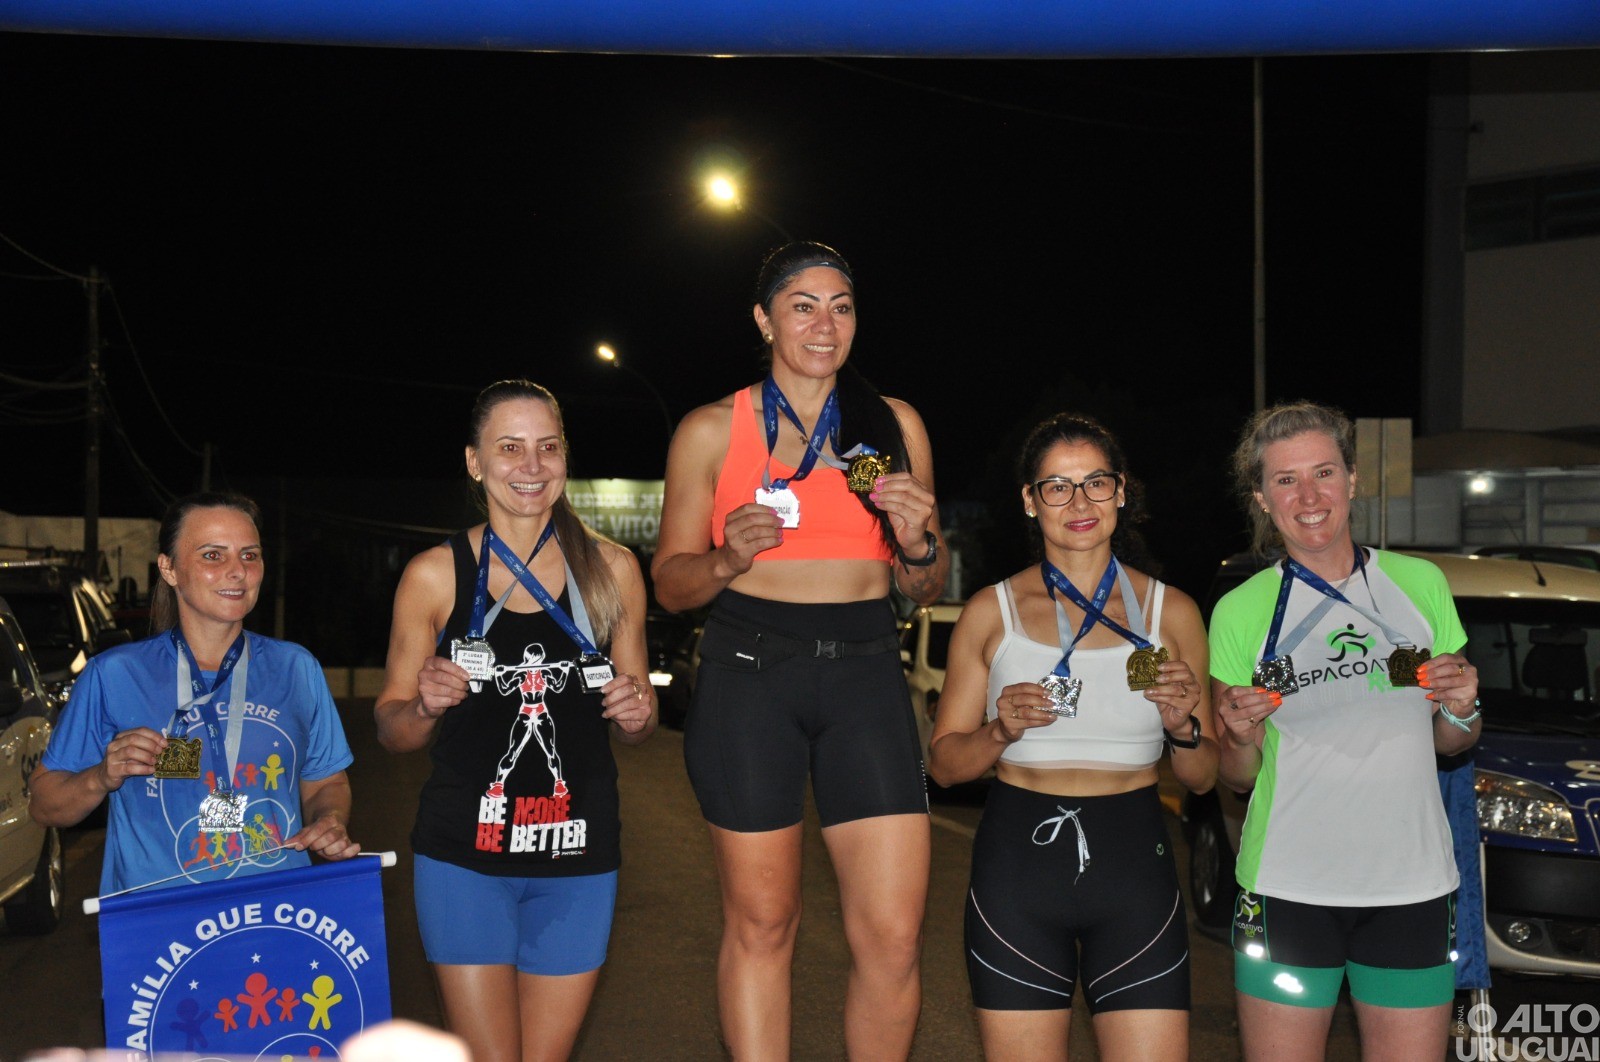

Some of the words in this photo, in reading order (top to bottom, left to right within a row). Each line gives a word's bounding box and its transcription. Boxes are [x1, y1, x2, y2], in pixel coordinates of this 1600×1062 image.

[609, 512, 661, 540] VITÓ
[215, 701, 280, 722] CRRE
[478, 795, 508, 824] BE
[513, 794, 571, 825] MORE
[475, 822, 505, 853] BE
[509, 818, 587, 853] BETTER
[195, 903, 263, 941] QUE
[274, 903, 371, 970] CORRE
